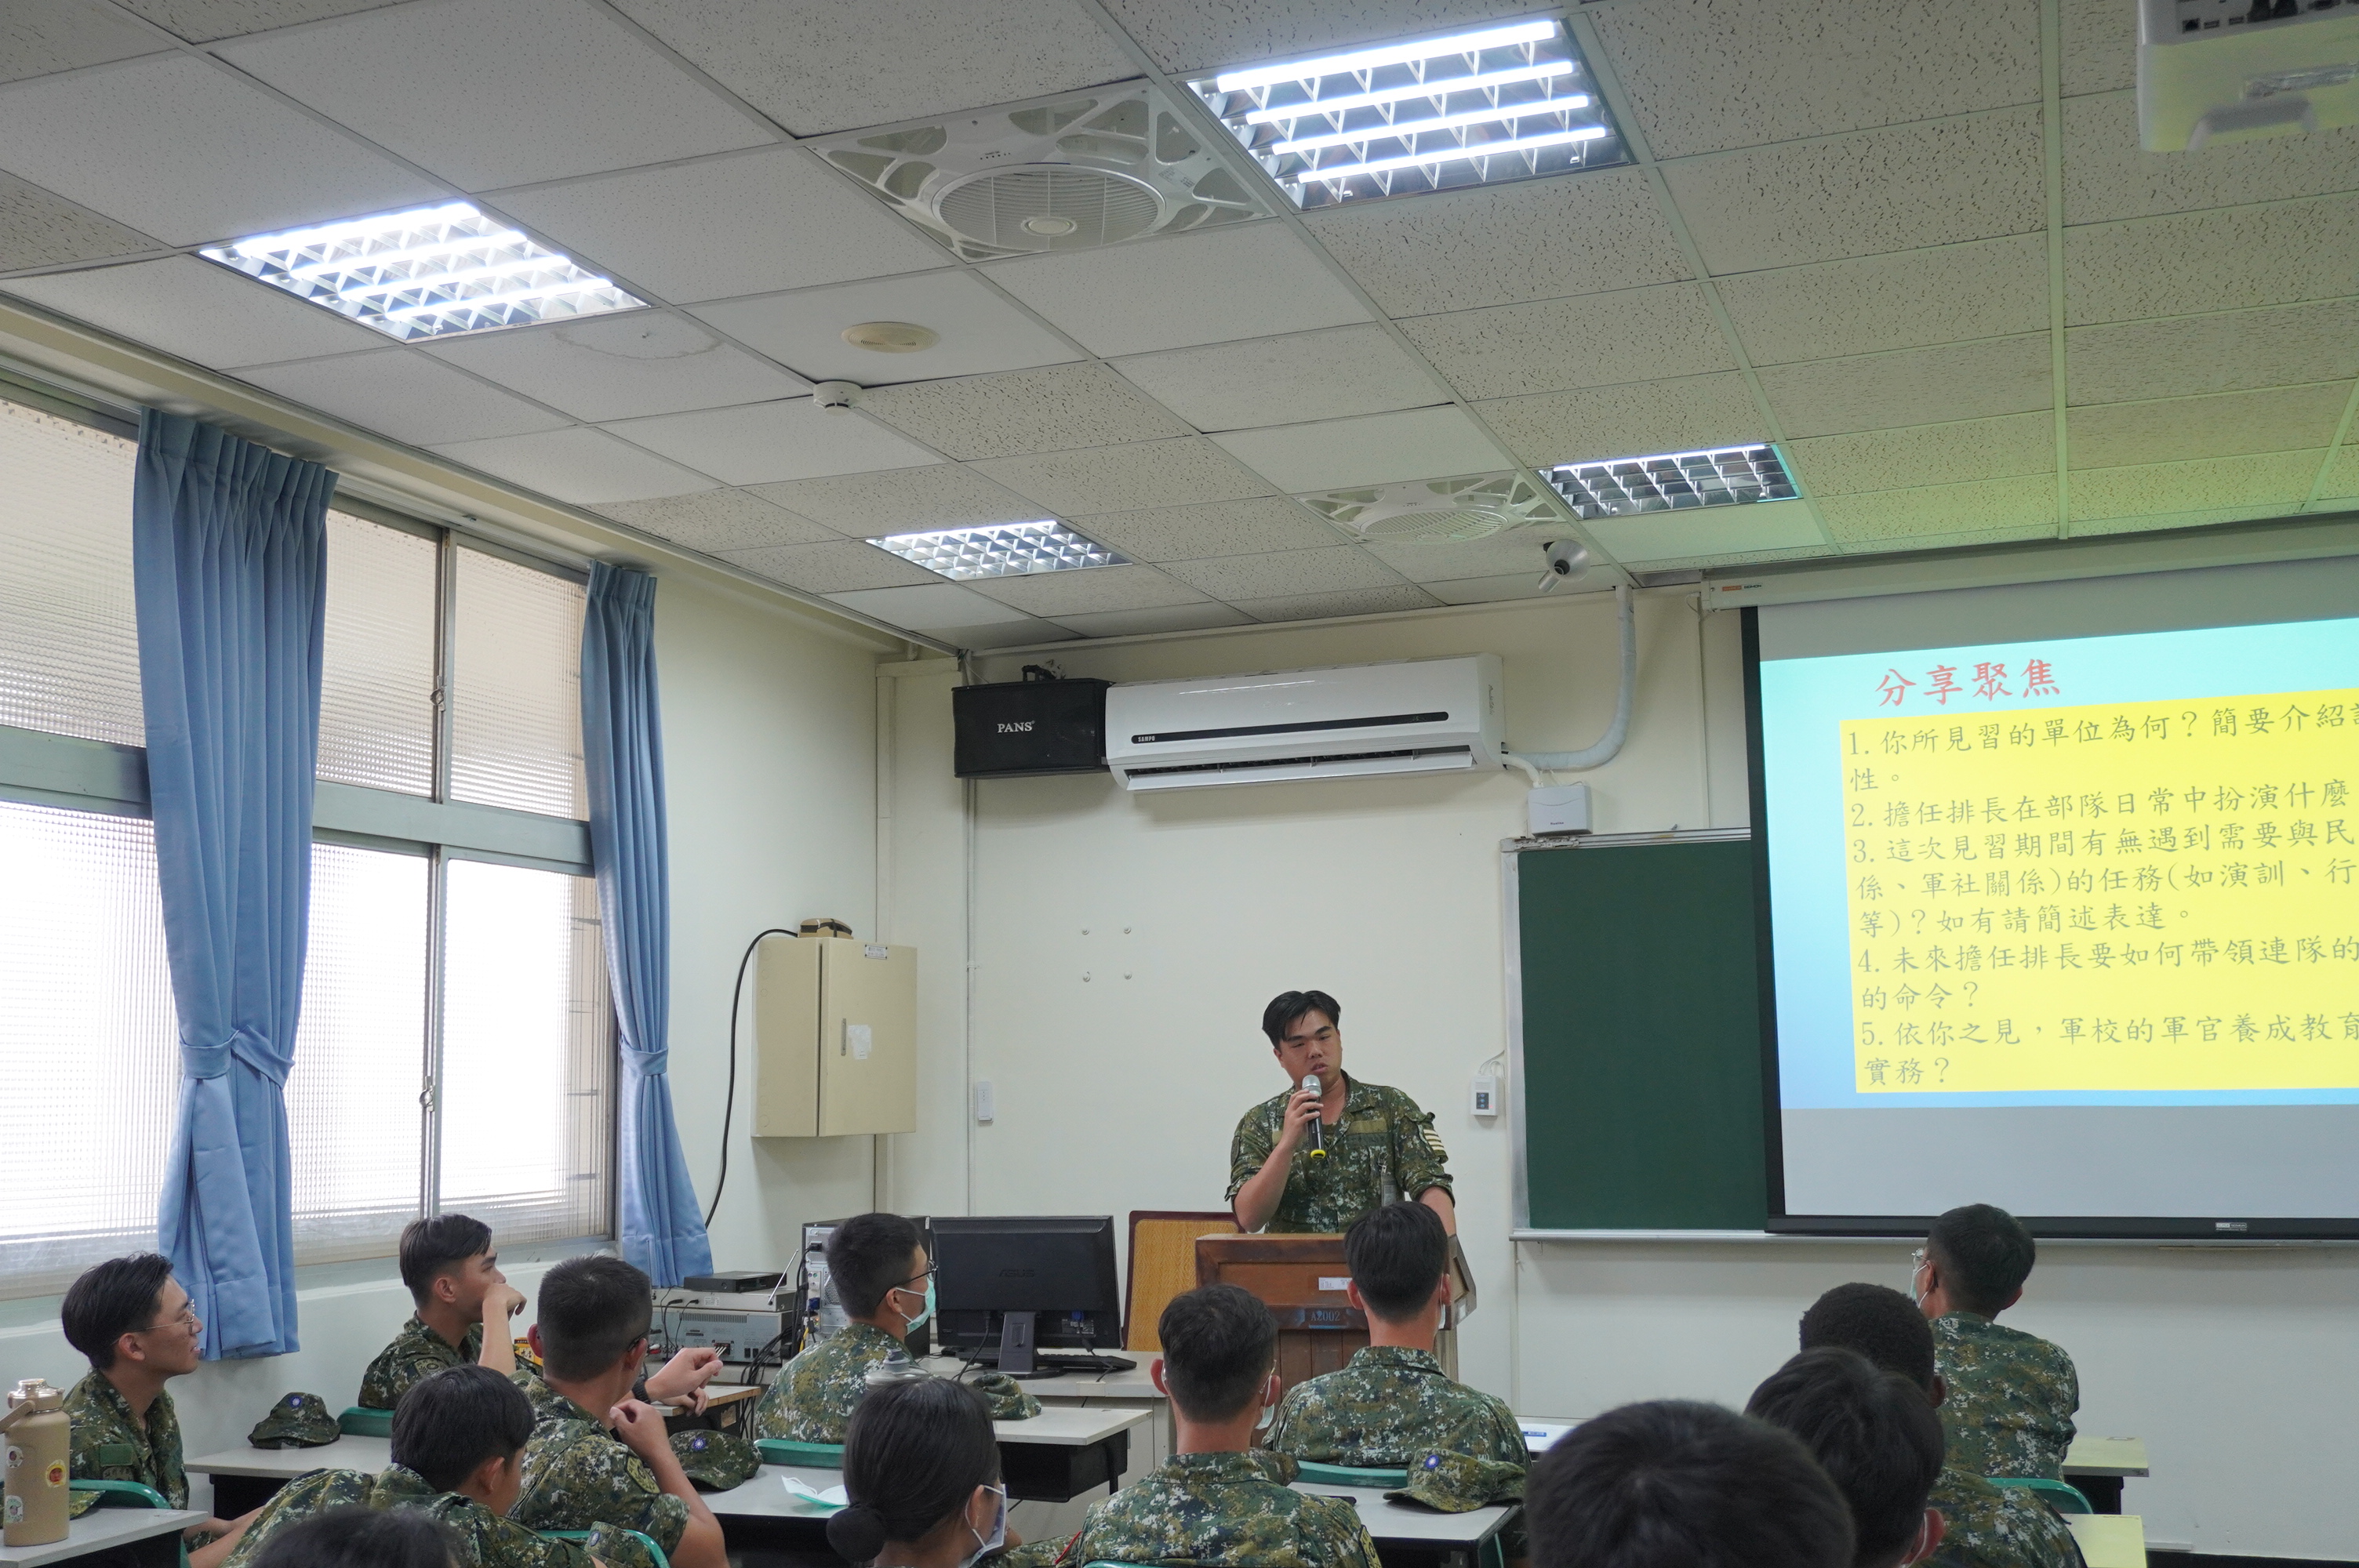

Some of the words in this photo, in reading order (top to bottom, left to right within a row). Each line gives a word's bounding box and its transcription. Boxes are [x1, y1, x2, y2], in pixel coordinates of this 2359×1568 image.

[1875, 659, 2060, 706] 分享聚焦
[997, 721, 1033, 733] PANS
[1861, 981, 1979, 1011] 的命令？
[1864, 1057, 1950, 1086] 實務？
[998, 1269, 1035, 1278] ASUS
[1310, 1310, 1340, 1322] A2002
